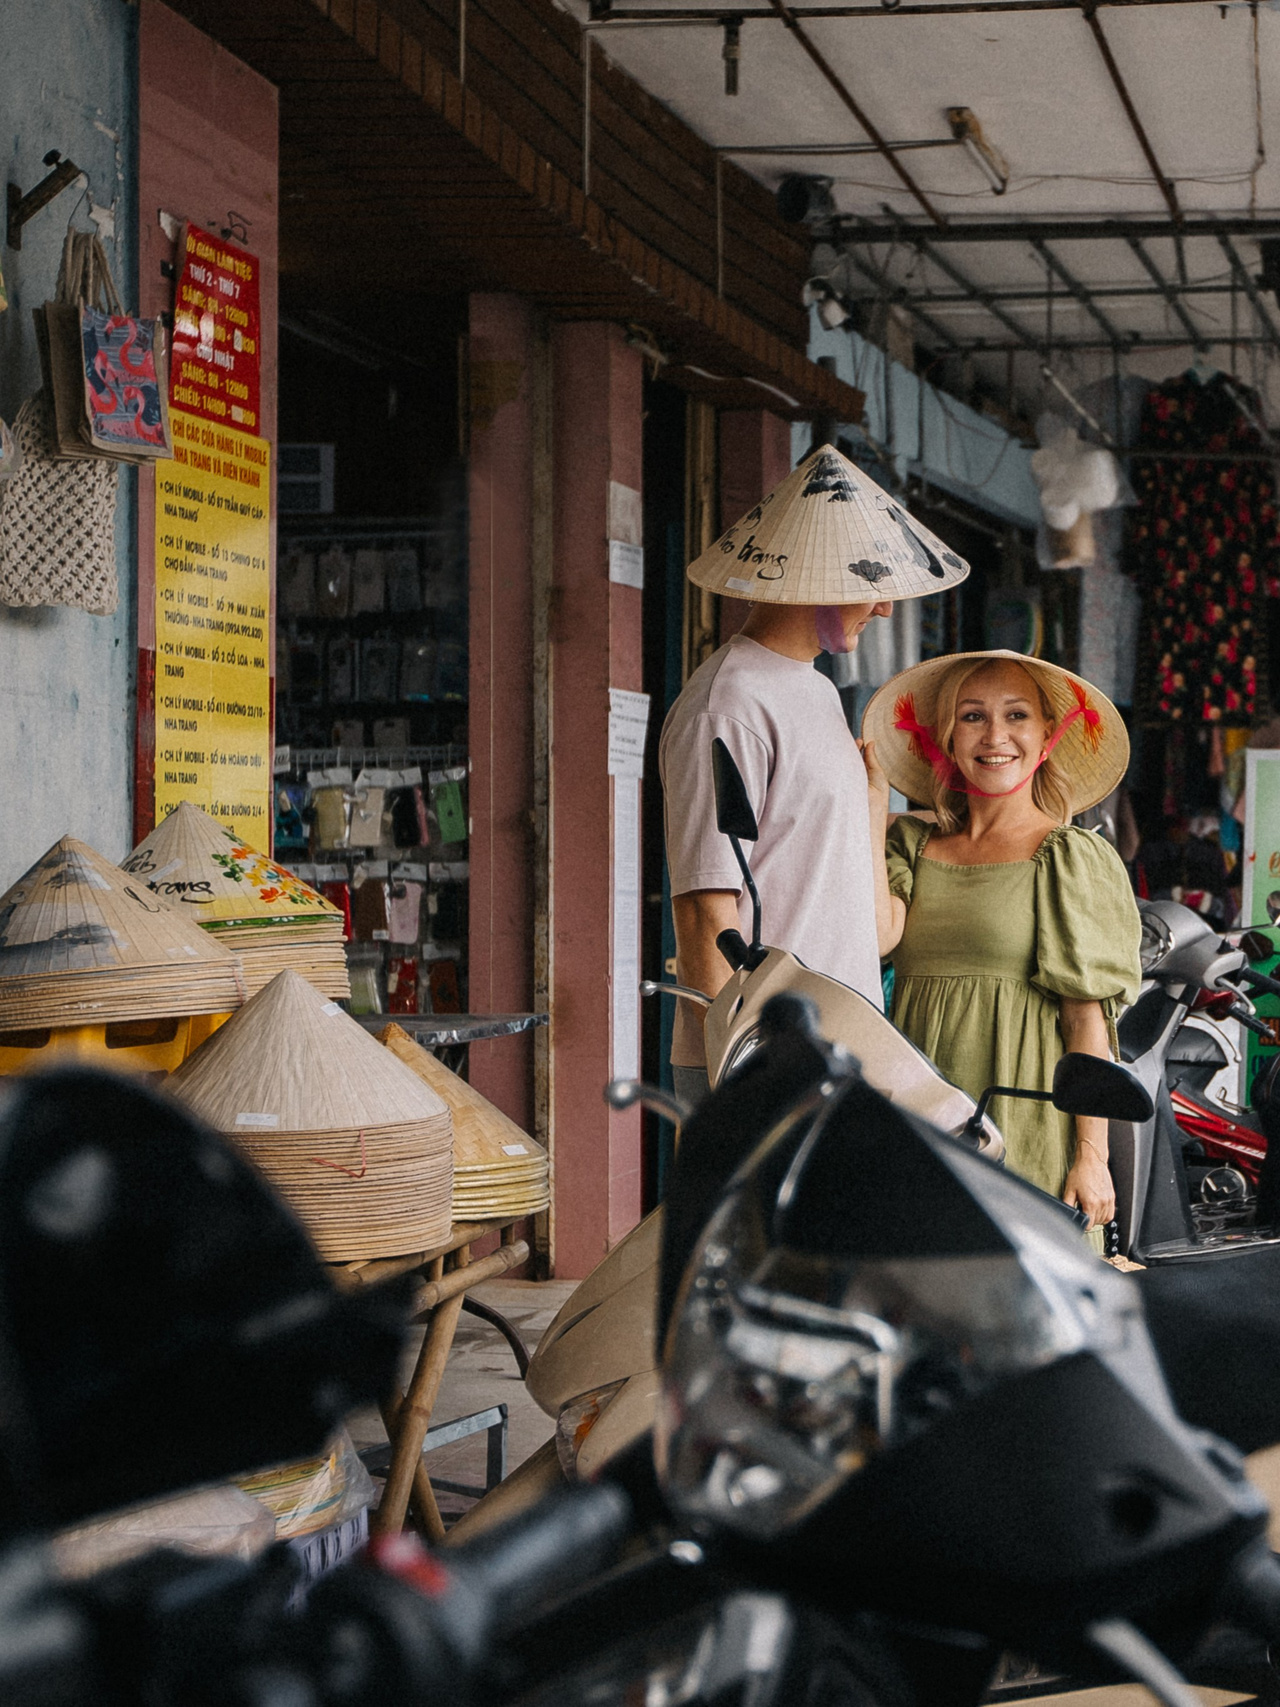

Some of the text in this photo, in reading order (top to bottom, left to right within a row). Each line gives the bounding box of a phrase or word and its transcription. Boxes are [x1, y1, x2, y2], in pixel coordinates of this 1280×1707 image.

[206, 271, 213, 287] 2
[234, 284, 240, 299] 7
[189, 450, 212, 473] TRANG
[244, 444, 267, 467] MOBILE
[164, 480, 174, 494] CH
[175, 481, 182, 496] LÝ
[182, 485, 204, 504] MOBILE
[164, 503, 198, 523] NHA TRANG
[164, 535, 174, 549] CH
[176, 535, 183, 550] LÝ
[185, 539, 206, 556] MOBILE
[196, 564, 208, 577] NHA
[209, 567, 228, 582] TRANG
[164, 588, 174, 602] CH
[177, 588, 184, 604] LÝ
[187, 593, 209, 609] MOBILE
[193, 616, 205, 629] NHA
[206, 619, 224, 633] TRANG
[164, 642, 174, 655] CH
[176, 641, 183, 656] LÝ
[184, 645, 205, 660] MOBILE
[237, 654, 249, 667] LOA
[253, 657, 265, 669] NHA
[164, 664, 185, 679] TRANG
[164, 696, 174, 709] CH
[175, 694, 182, 709] LÝ
[182, 698, 204, 712] MOBILE
[164, 718, 198, 733] NHA TRANG
[164, 749, 174, 762] CH
[176, 747, 183, 763] LÝ
[184, 751, 205, 765] MOBILE
[164, 771, 198, 785] NHA TRANG
